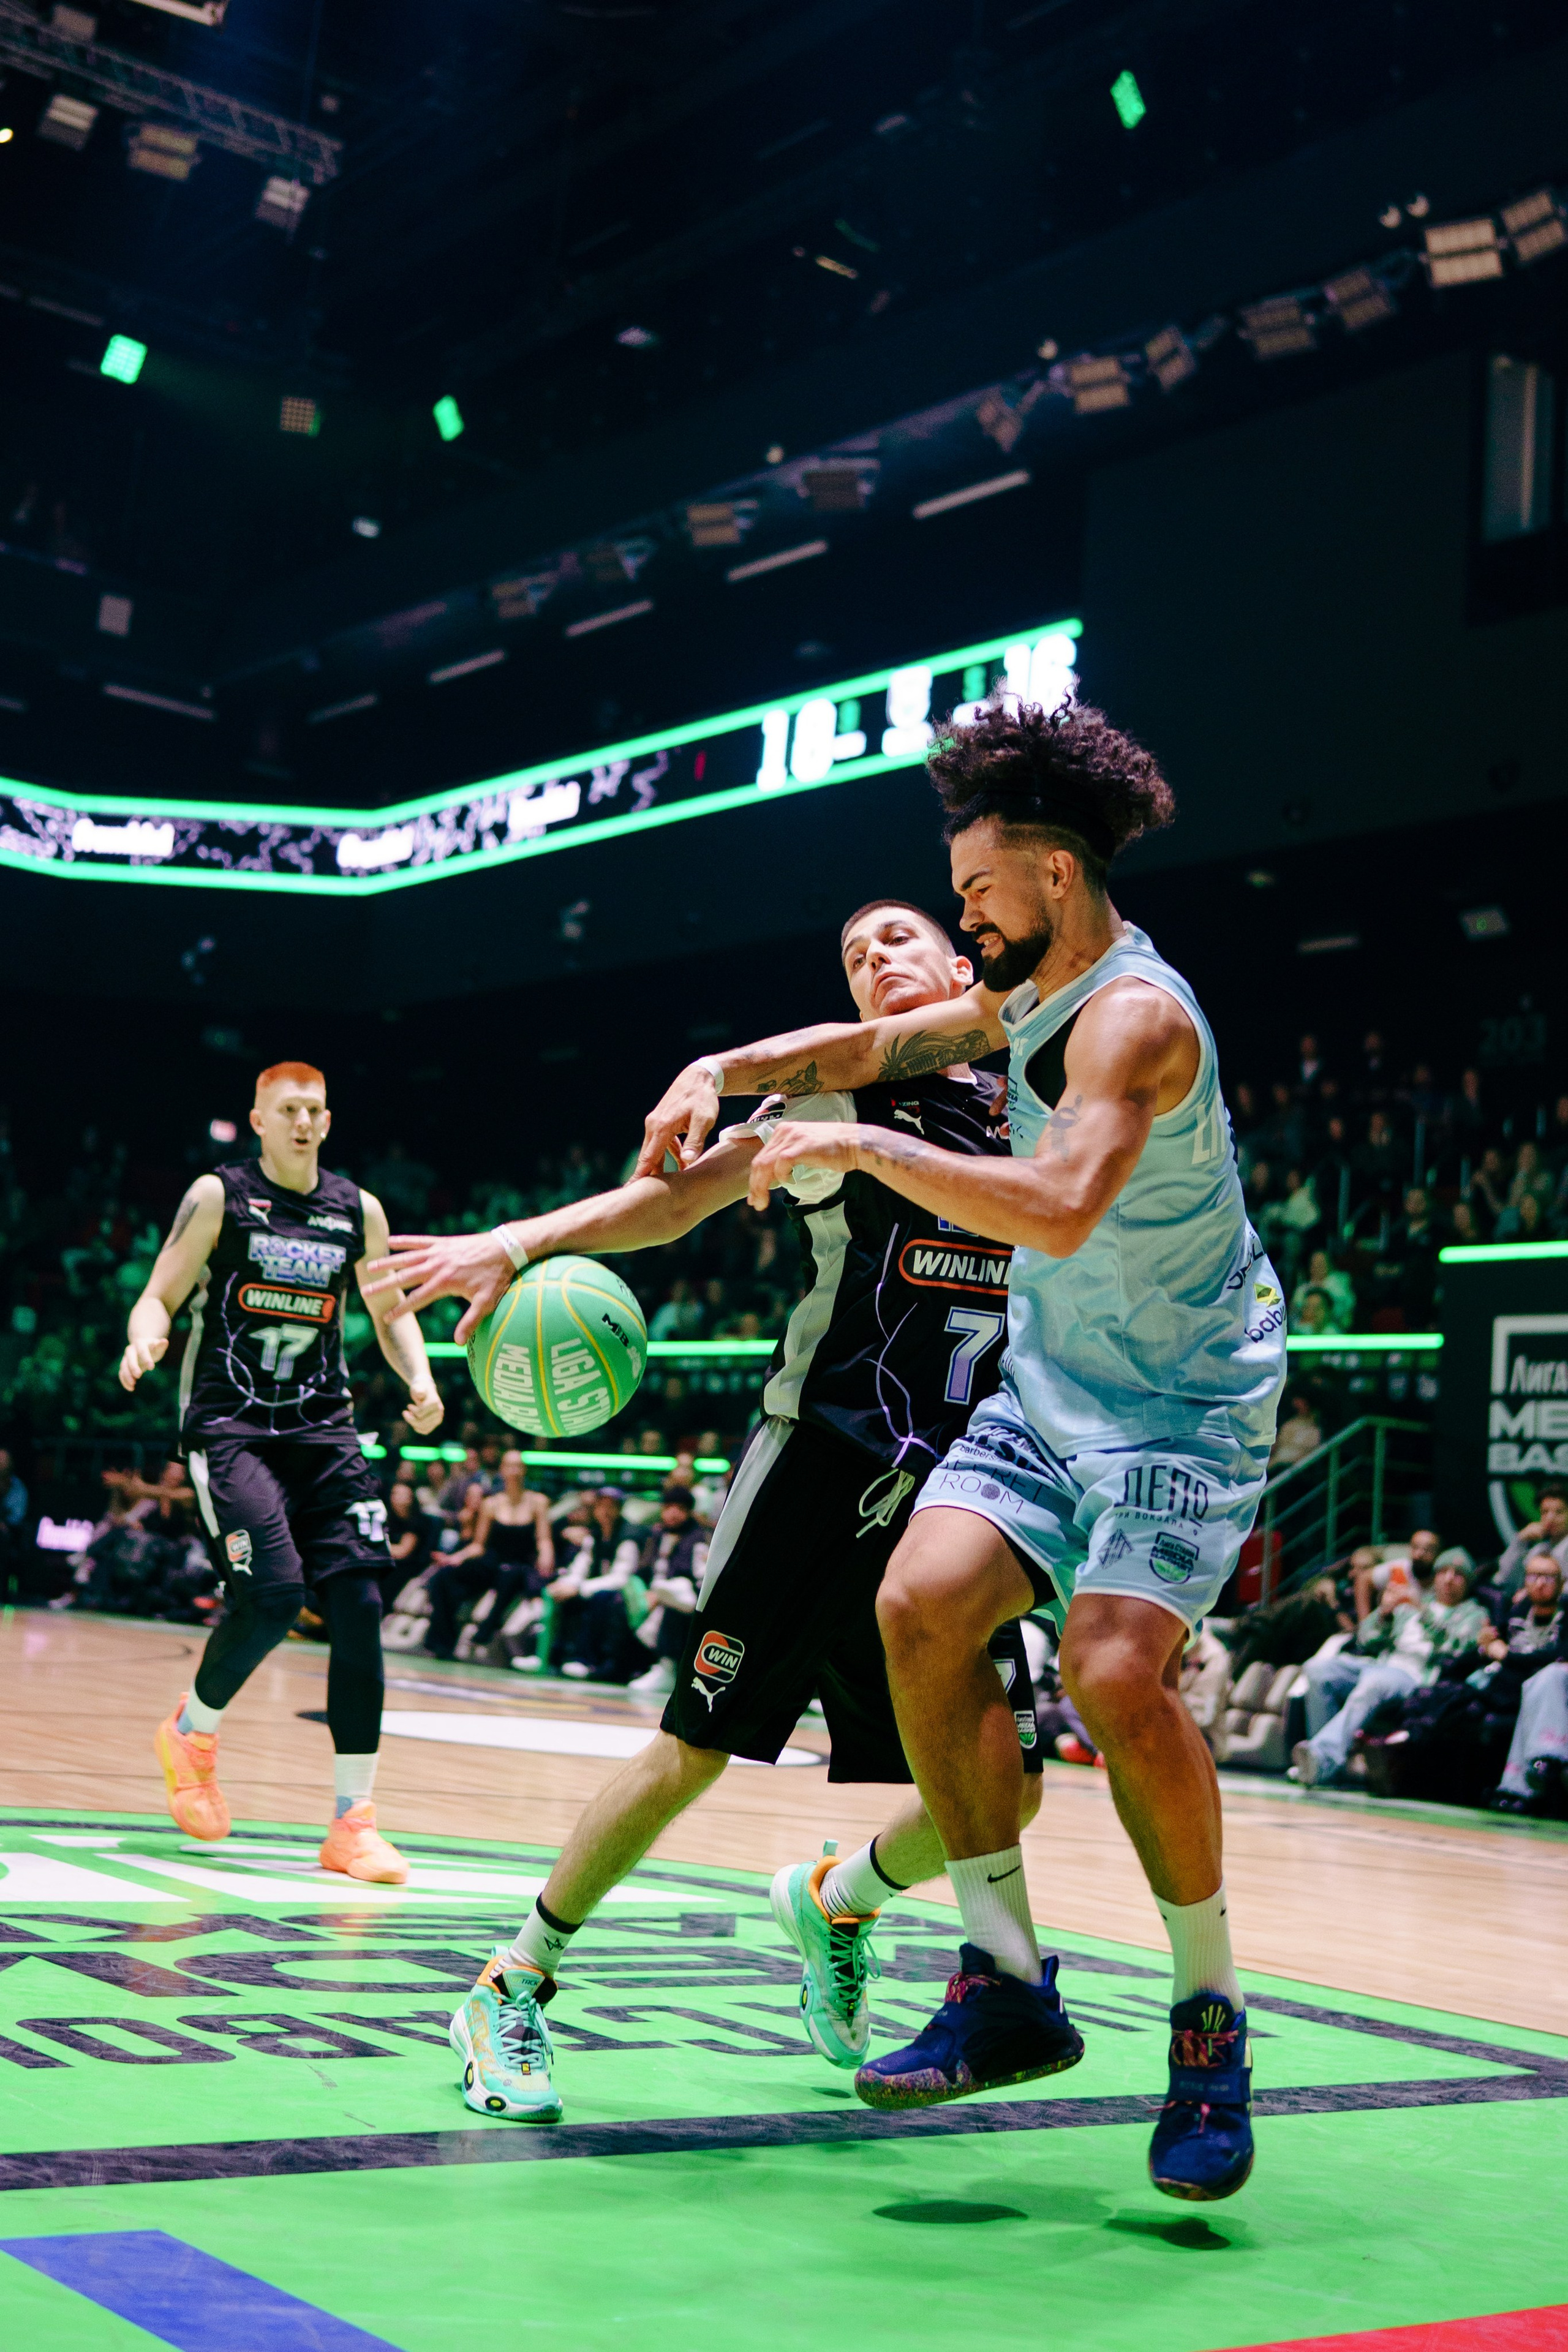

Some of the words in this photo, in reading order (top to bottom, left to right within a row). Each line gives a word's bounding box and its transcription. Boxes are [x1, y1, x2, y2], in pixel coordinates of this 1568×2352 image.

[249, 1233, 346, 1269] ROCKET
[262, 1257, 331, 1286] TEAM
[246, 1289, 324, 1316] WINLINE
[249, 1324, 319, 1381] 17
[493, 1343, 536, 1402] MEDIA
[551, 1337, 601, 1395] LIGA
[944, 1306, 1006, 1405] 7
[1114, 1465, 1208, 1520] ДЕПО
[344, 1499, 388, 1542] 17
[708, 1648, 738, 1668] WIN
